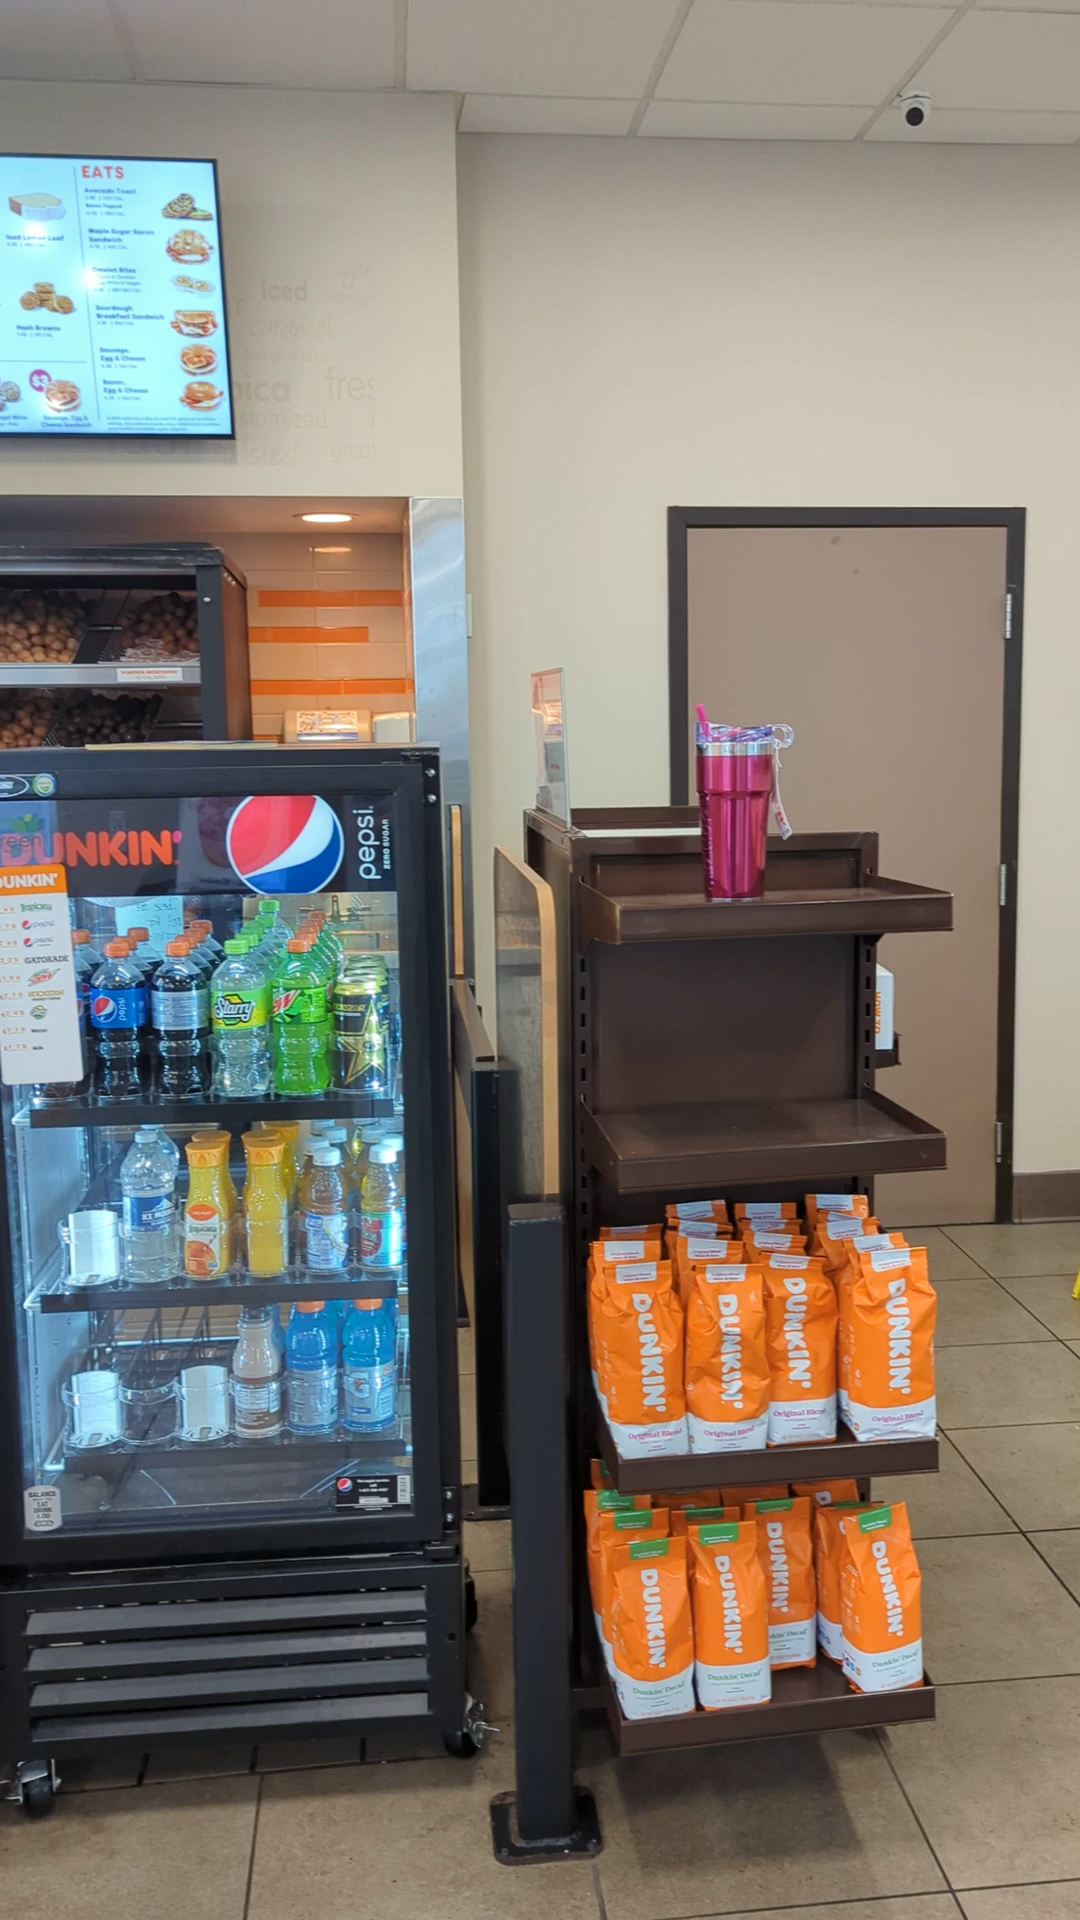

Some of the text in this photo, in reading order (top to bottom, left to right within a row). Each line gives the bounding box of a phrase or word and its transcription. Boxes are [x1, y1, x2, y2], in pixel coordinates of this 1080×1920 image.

[82, 165, 125, 179] EATS
[261, 279, 308, 301] iced
[234, 373, 291, 402] ica
[239, 409, 328, 429] stomized
[1, 830, 183, 867] DUNKIN'
[382, 819, 391, 870] ZERO SUGAR
[24, 955, 69, 964] GATORADE
[117, 998, 127, 1021] pepsi
[213, 998, 257, 1023] Starry
[783, 1277, 812, 1388] DUNKIN'
[885, 1277, 912, 1394] DUNKIN'
[632, 1293, 667, 1412] DUNKIN'
[718, 1294, 744, 1409] DUNKIN'
[774, 1407, 825, 1418] Original Blend
[872, 1410, 924, 1423] Original Blend
[628, 1431, 661, 1441] Original
[661, 1427, 683, 1437] Blend
[704, 1429, 737, 1439] Original
[737, 1425, 755, 1435] Blend
[766, 1522, 789, 1613] DUNKIN'
[871, 1540, 904, 1637] DUNKIN'
[714, 1555, 744, 1654] DUNKIN'
[640, 1568, 666, 1668] DUNKIN'
[707, 1669, 762, 1681] Dunkin' Decaf
[872, 1657, 900, 1669] Dunkin'
[633, 1685, 664, 1695] Dunkin'
[665, 1681, 686, 1694] Decaf
